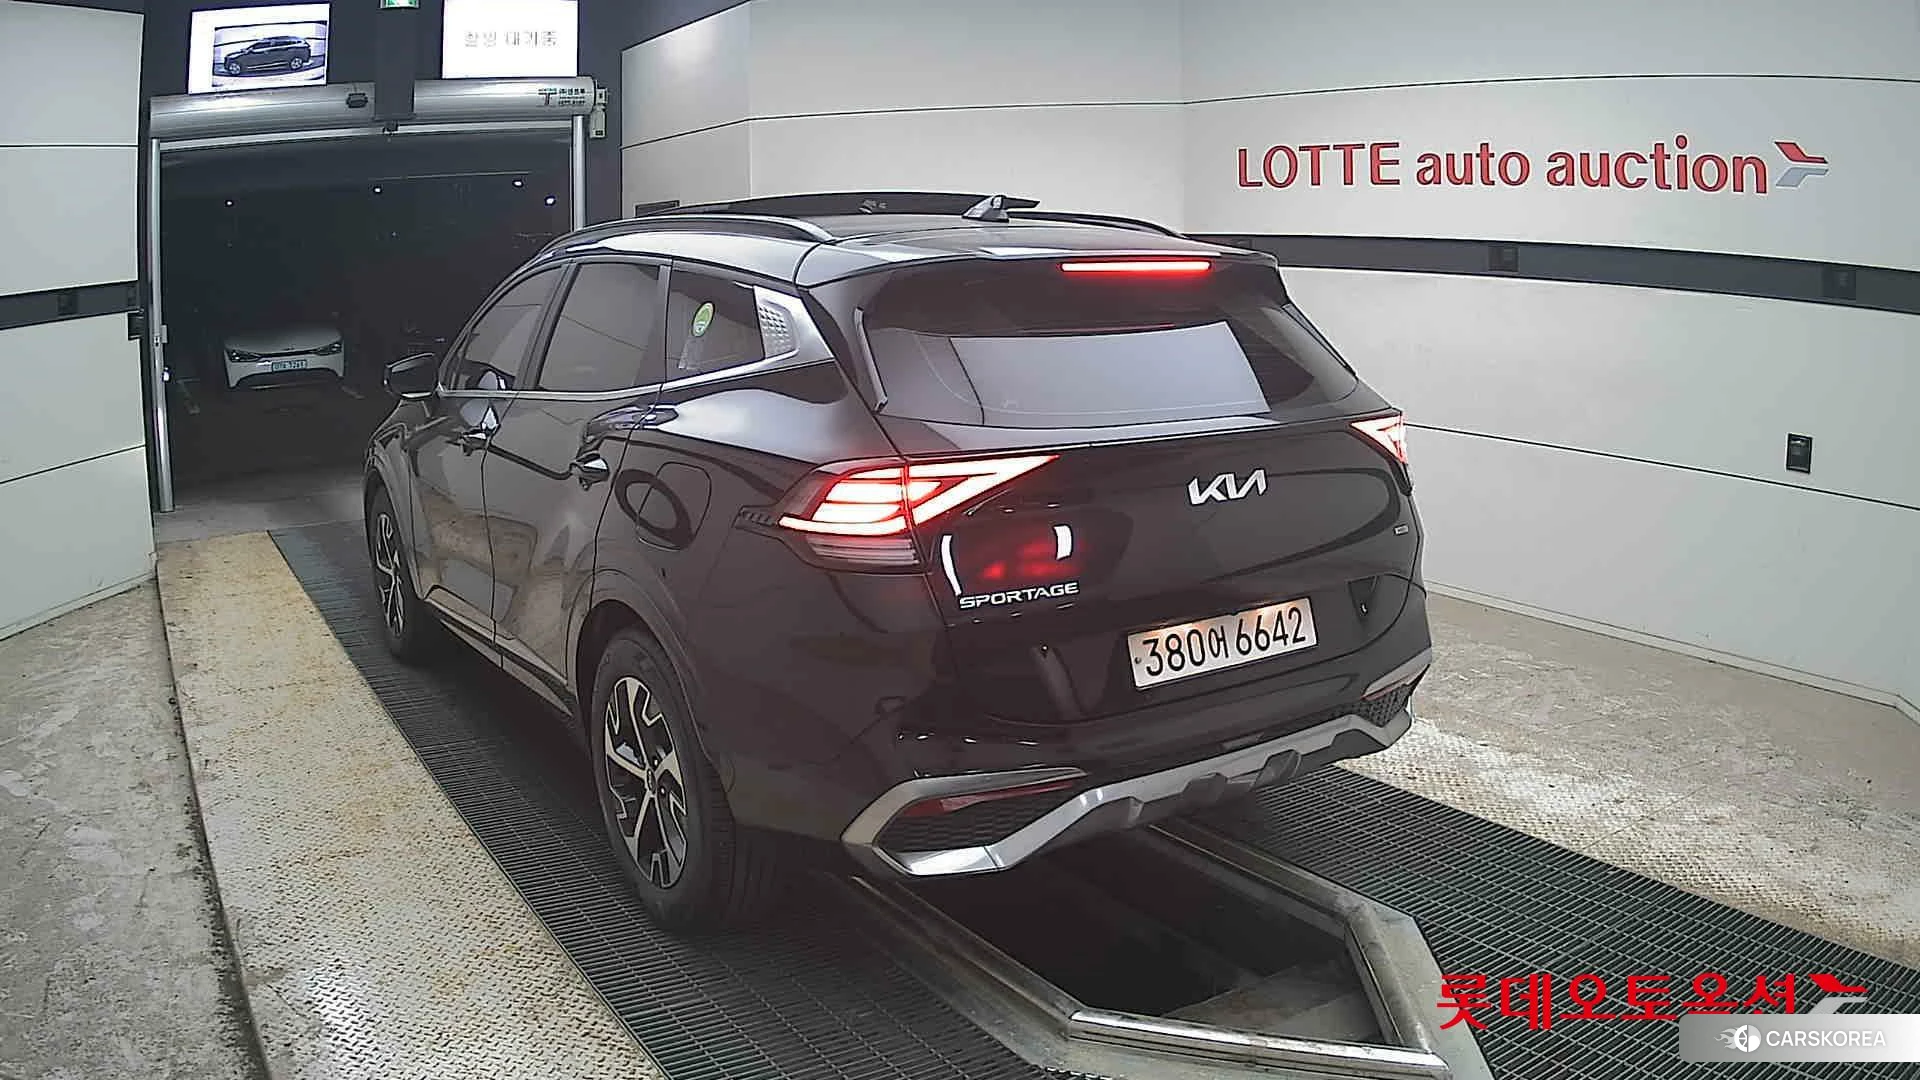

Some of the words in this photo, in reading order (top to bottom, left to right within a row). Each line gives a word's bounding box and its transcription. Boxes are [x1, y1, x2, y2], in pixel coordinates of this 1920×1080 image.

[1238, 142, 1400, 188] LOTTE
[1416, 142, 1531, 187] auto
[1546, 135, 1767, 194] auction
[1188, 469, 1267, 505] KIA
[959, 582, 1079, 609] SPORTAGE
[1142, 625, 1229, 676] 380어
[1235, 606, 1306, 656] 6642
